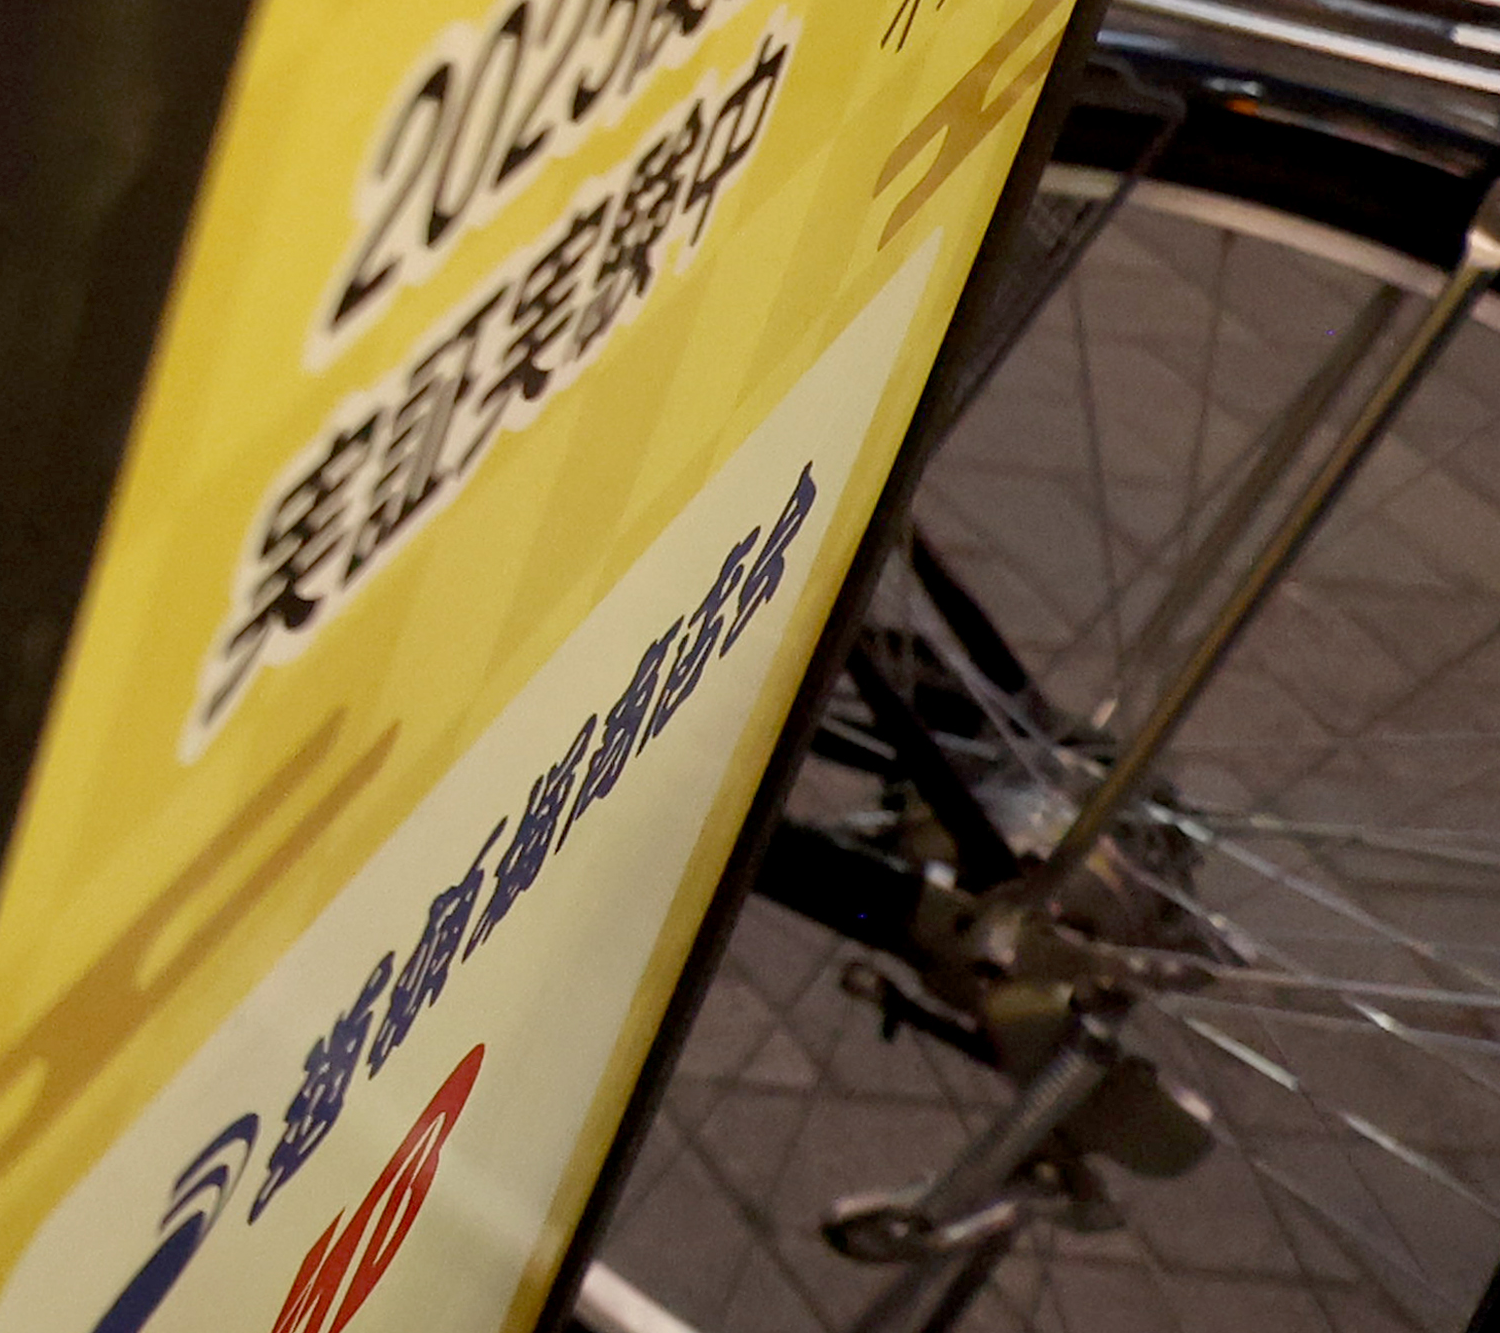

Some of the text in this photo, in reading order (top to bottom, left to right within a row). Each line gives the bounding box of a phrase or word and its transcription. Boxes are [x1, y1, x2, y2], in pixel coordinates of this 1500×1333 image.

[200, 35, 792, 724] 実証実験中
